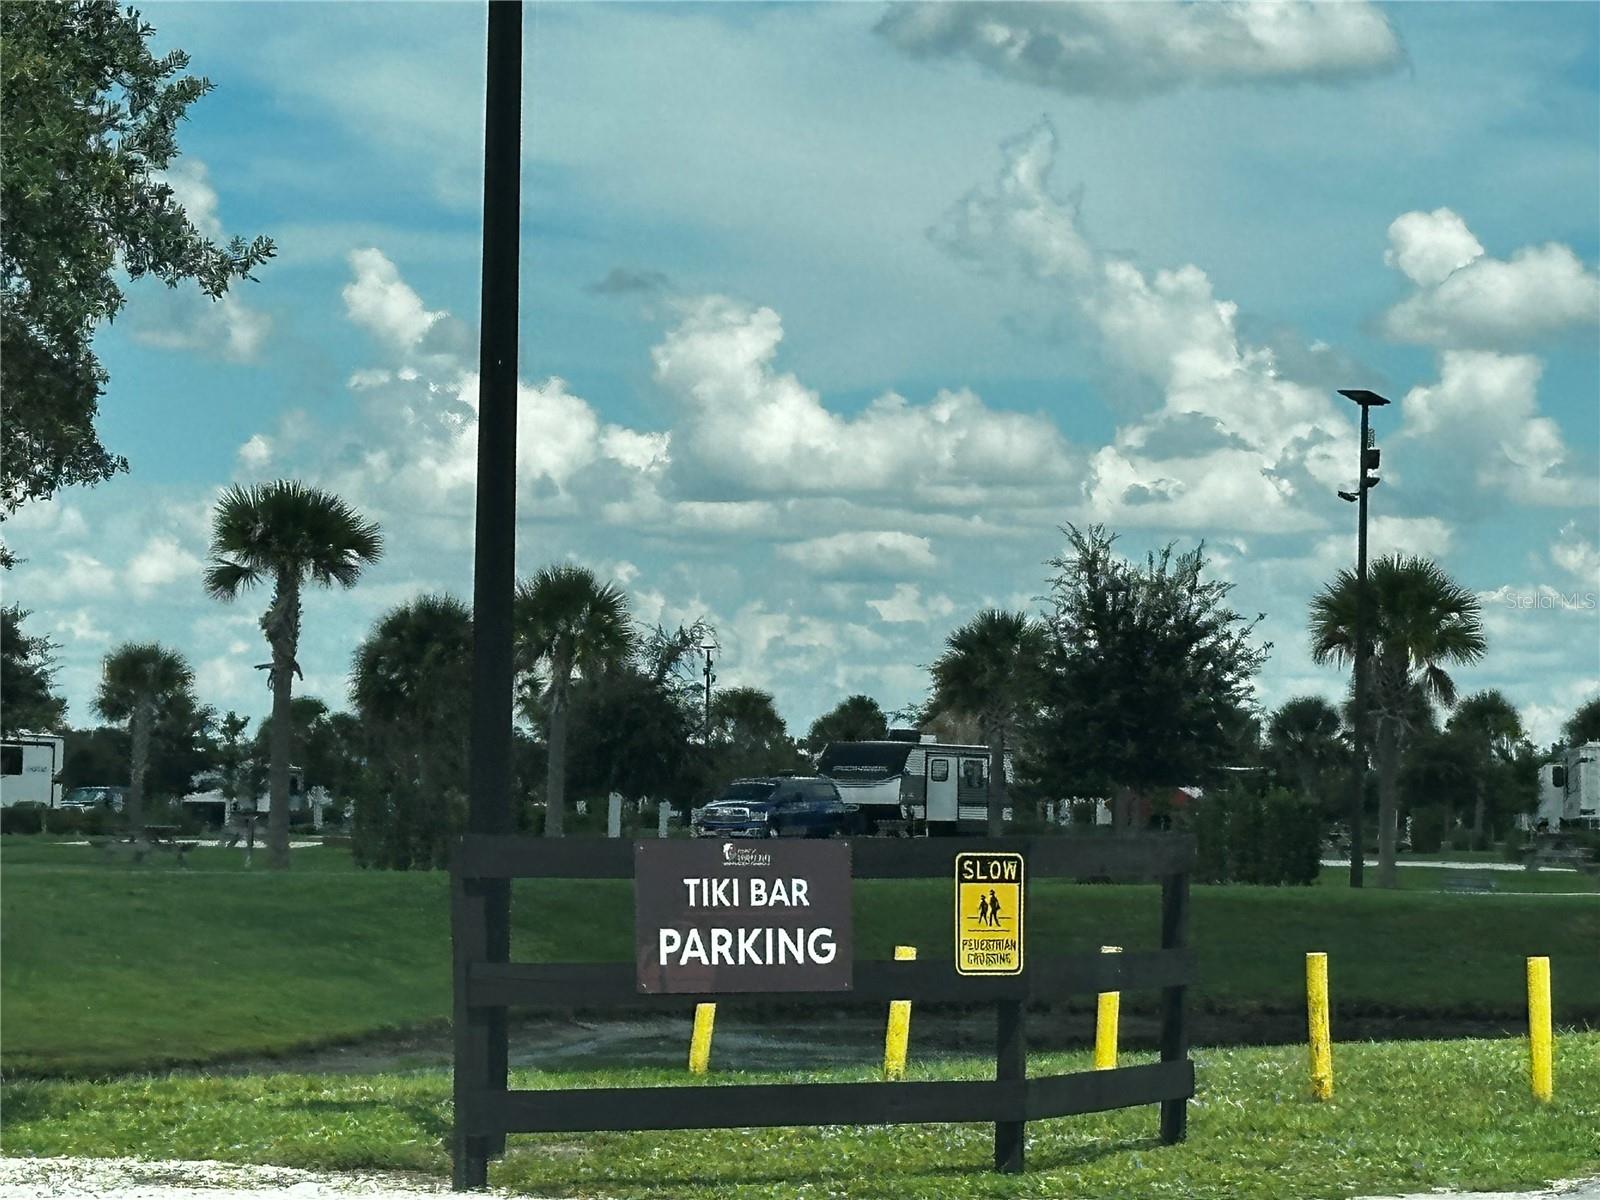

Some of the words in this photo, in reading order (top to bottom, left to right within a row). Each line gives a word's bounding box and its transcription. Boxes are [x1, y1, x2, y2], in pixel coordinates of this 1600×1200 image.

[962, 860, 1018, 880] SLOW
[683, 878, 740, 907] TIKI
[750, 878, 810, 907] BAR
[659, 927, 837, 966] PARKING
